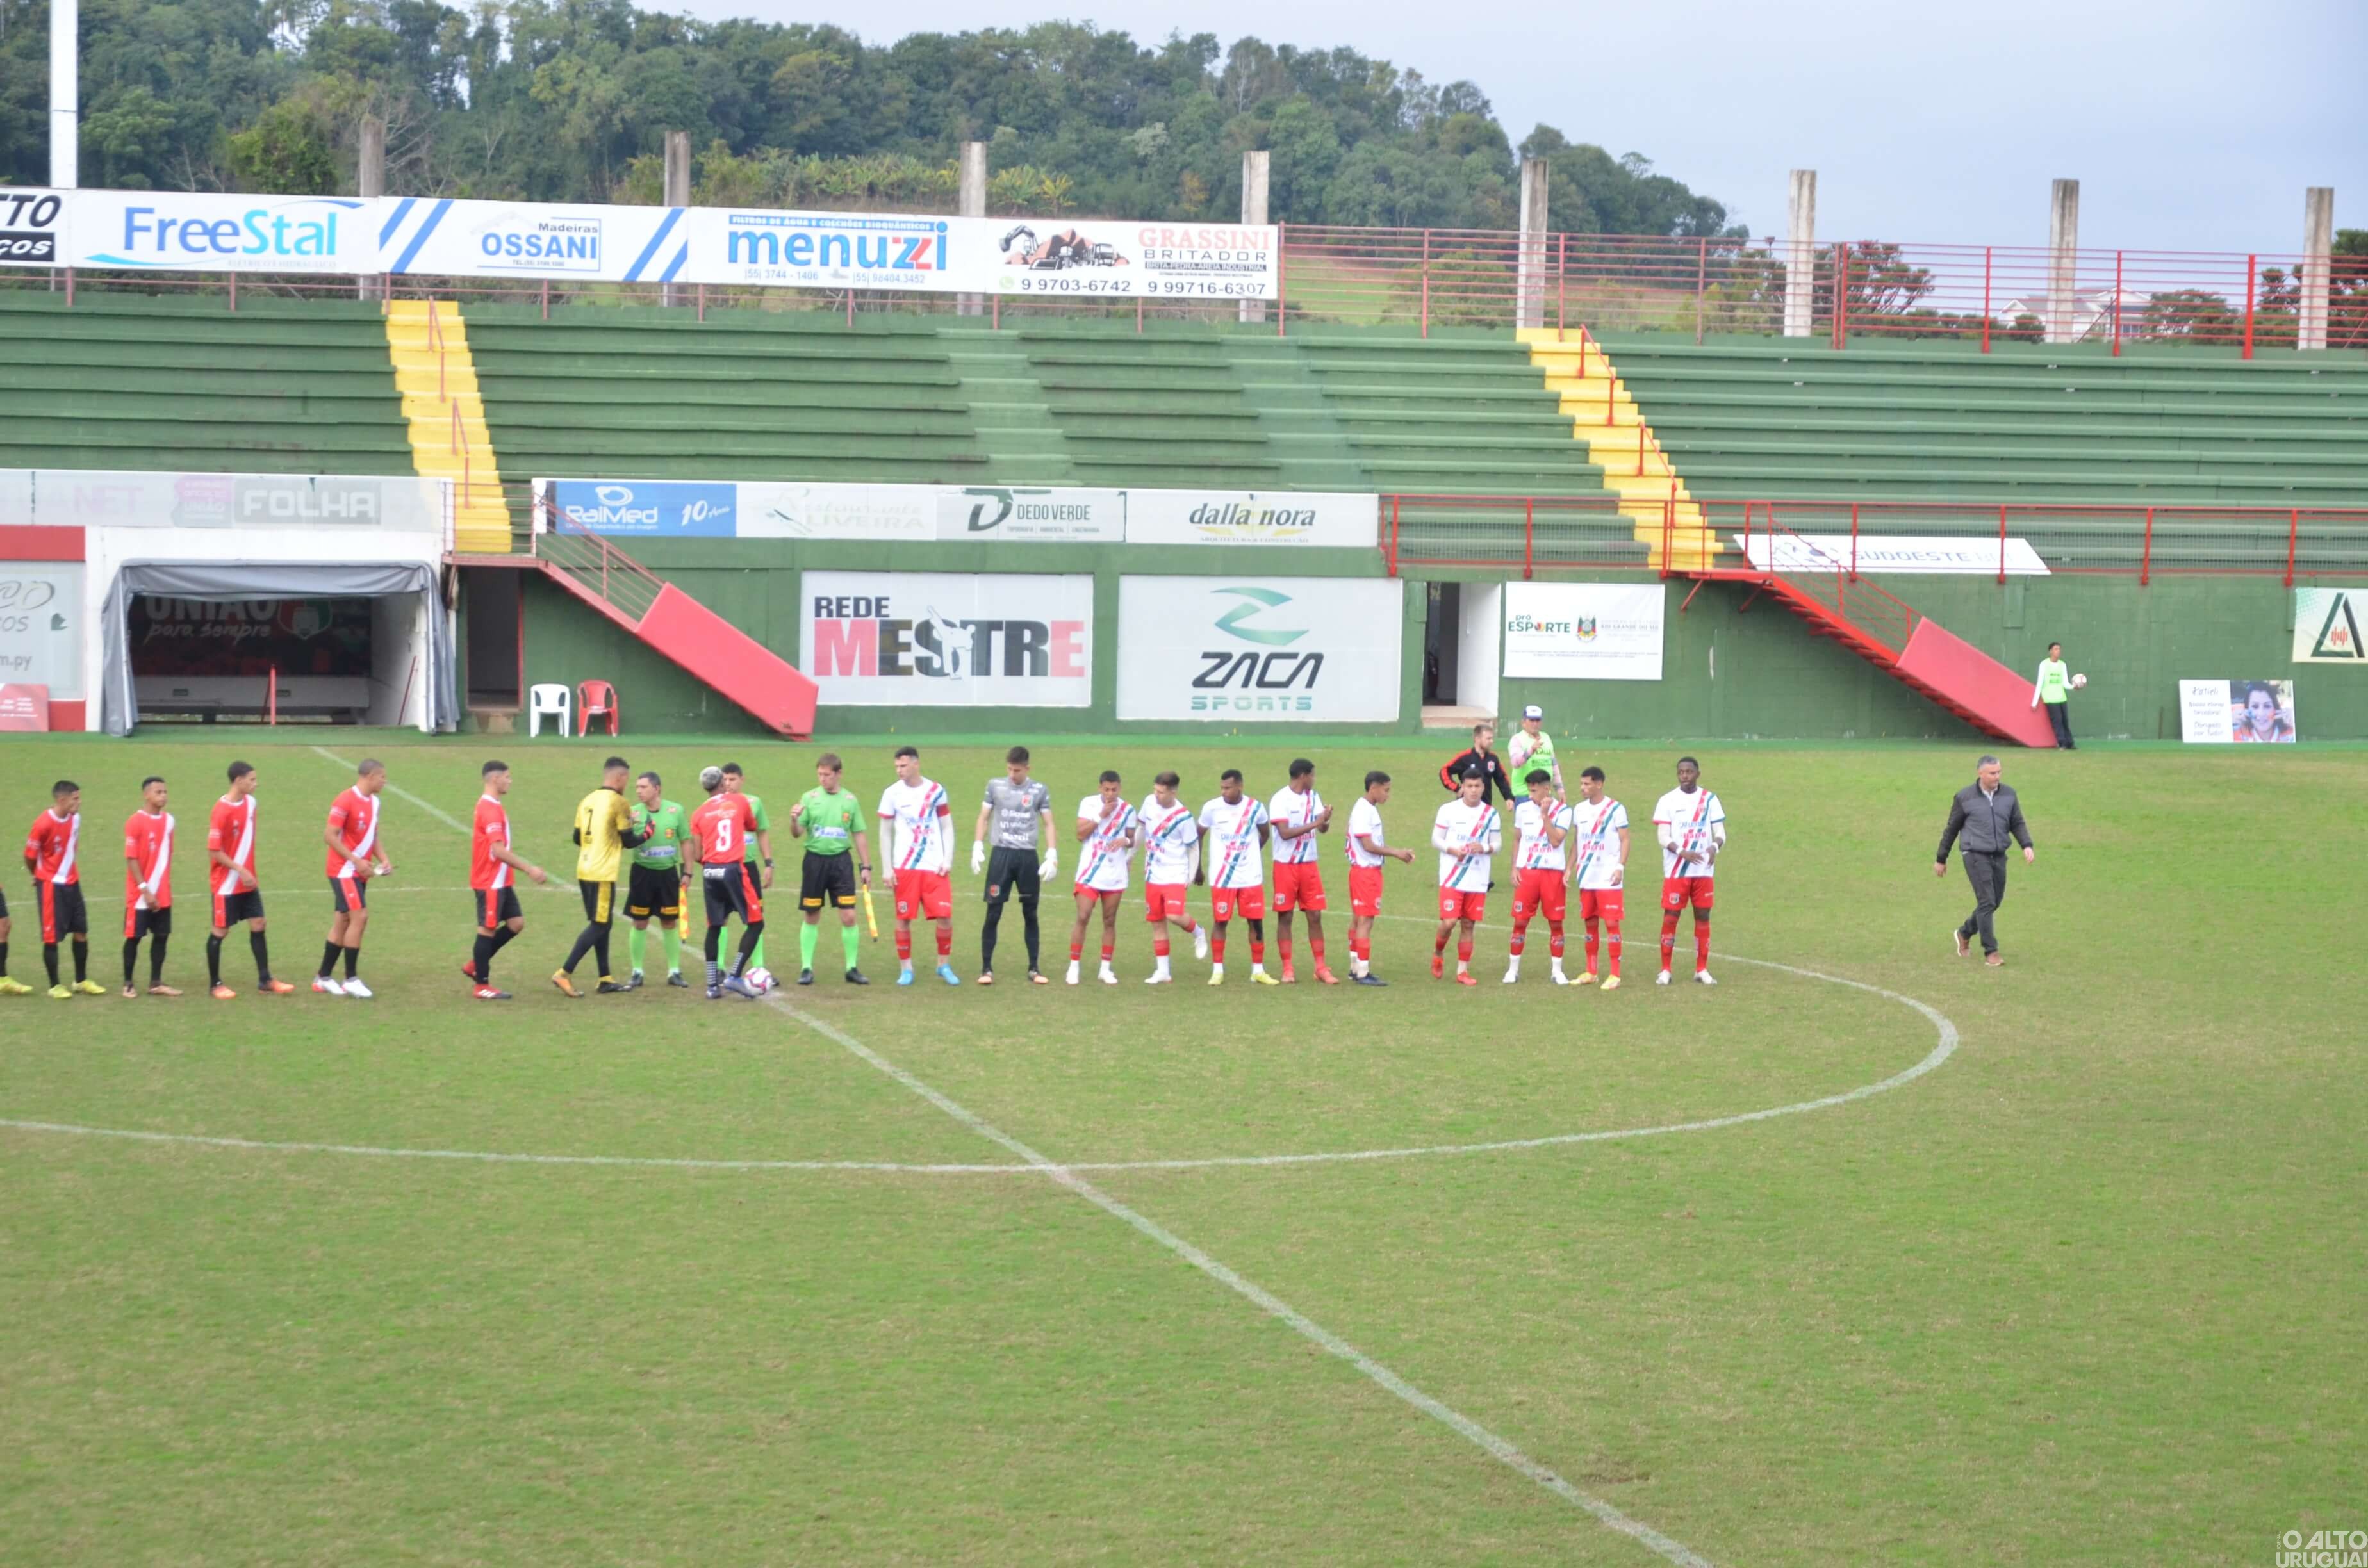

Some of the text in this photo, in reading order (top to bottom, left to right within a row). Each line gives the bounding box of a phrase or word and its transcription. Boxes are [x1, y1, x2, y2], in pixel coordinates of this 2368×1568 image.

[0, 194, 62, 227] TO
[124, 206, 337, 256] FreeStal
[539, 222, 598, 233] Madeiras
[733, 216, 767, 224] FILTROS
[784, 217, 809, 225] ÁGUA
[819, 219, 862, 228] COLCHÕES
[866, 220, 930, 231] BIOQUÂNTICOS
[482, 232, 597, 259] OSSANI
[728, 221, 948, 270] menuzzi
[1138, 228, 1270, 250] GRASSINI
[1144, 249, 1266, 261] BRITADOR
[765, 269, 787, 279] 3744
[797, 271, 819, 281] 1406
[1021, 279, 1131, 292] 9 9703-6742
[1148, 281, 1266, 295] 9 99716-6307
[243, 490, 375, 518] FOLHA
[681, 500, 707, 527] 10
[1017, 504, 1090, 521] DEDO VERDE
[1189, 503, 1316, 526] dalla nora
[814, 596, 890, 618] REDE
[814, 619, 1085, 677] MESTRE
[1192, 651, 1324, 689] ZACA
[1191, 696, 1312, 710] SPORTS
[584, 808, 593, 836] 1
[716, 819, 732, 852] 8
